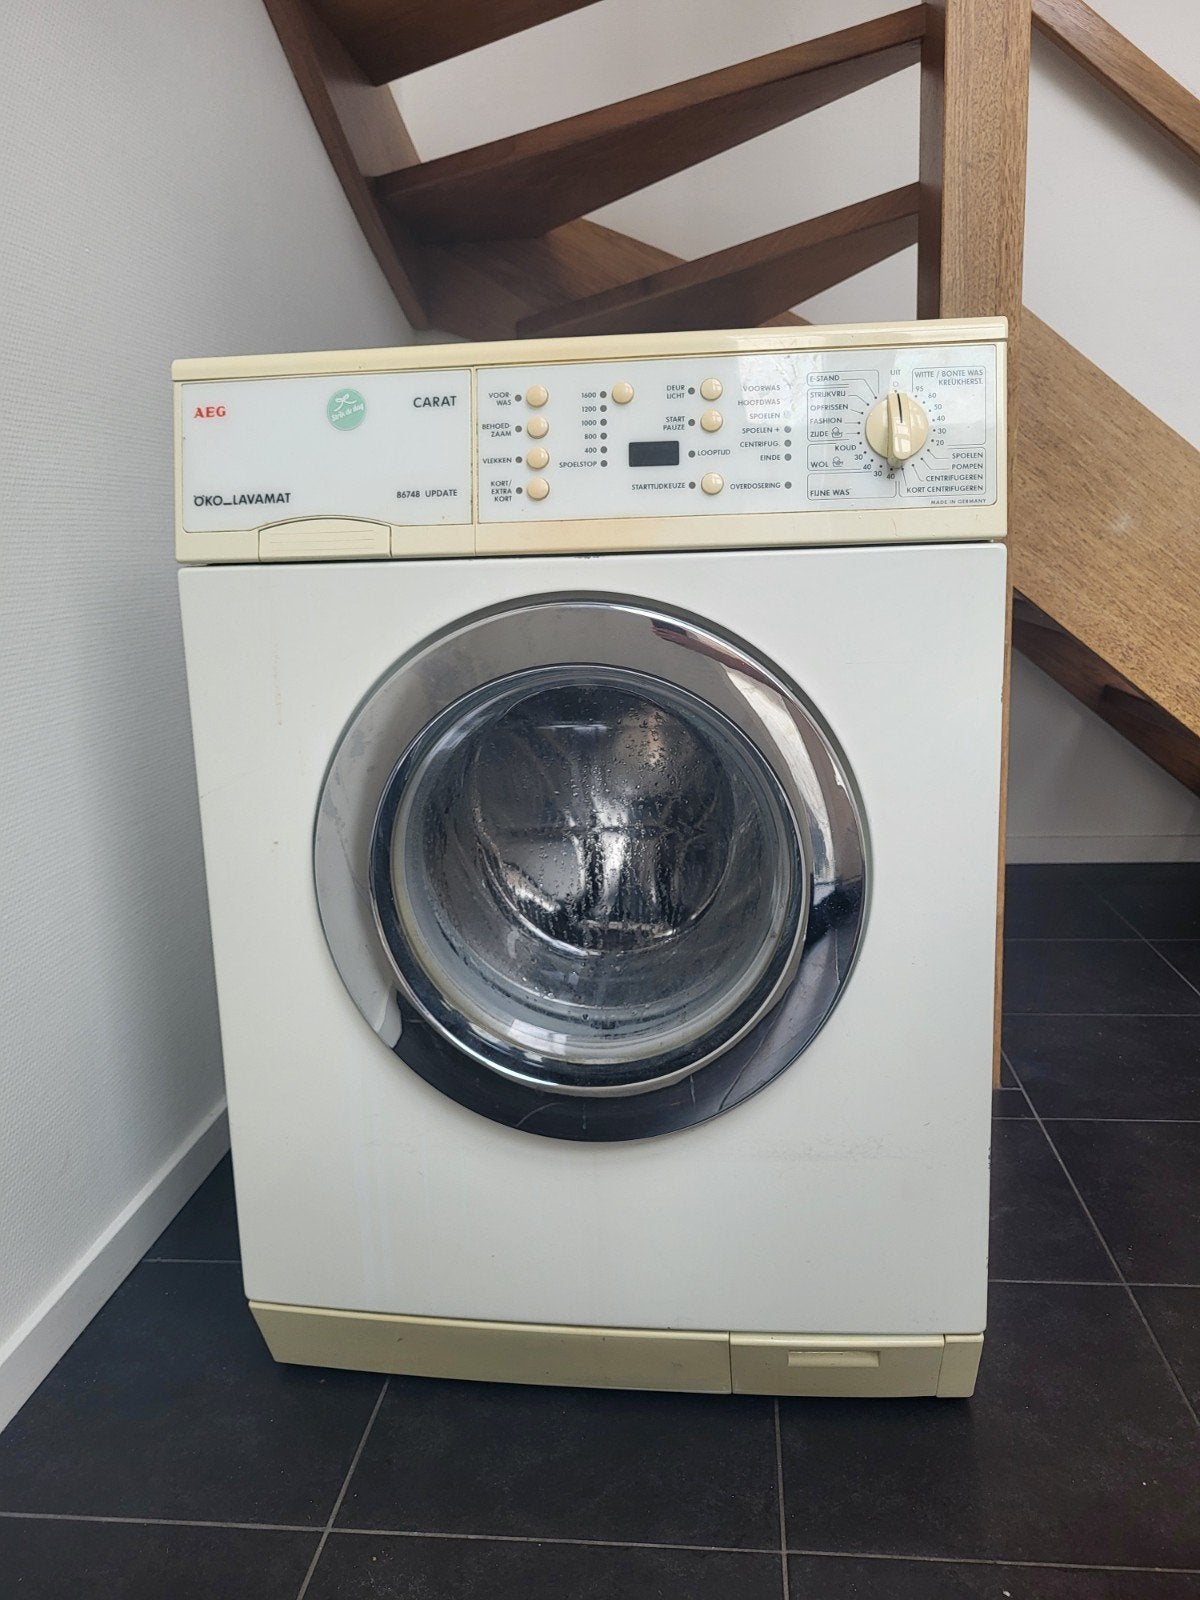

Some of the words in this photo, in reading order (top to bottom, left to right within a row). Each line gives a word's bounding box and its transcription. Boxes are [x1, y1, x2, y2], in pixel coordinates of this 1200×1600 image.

[413, 396, 457, 408] CARAT
[194, 406, 226, 418] AEG
[730, 482, 781, 490] OVERDOSERING
[396, 490, 420, 499] 86748
[425, 489, 458, 498] UPDATE
[832, 488, 850, 496] WAS
